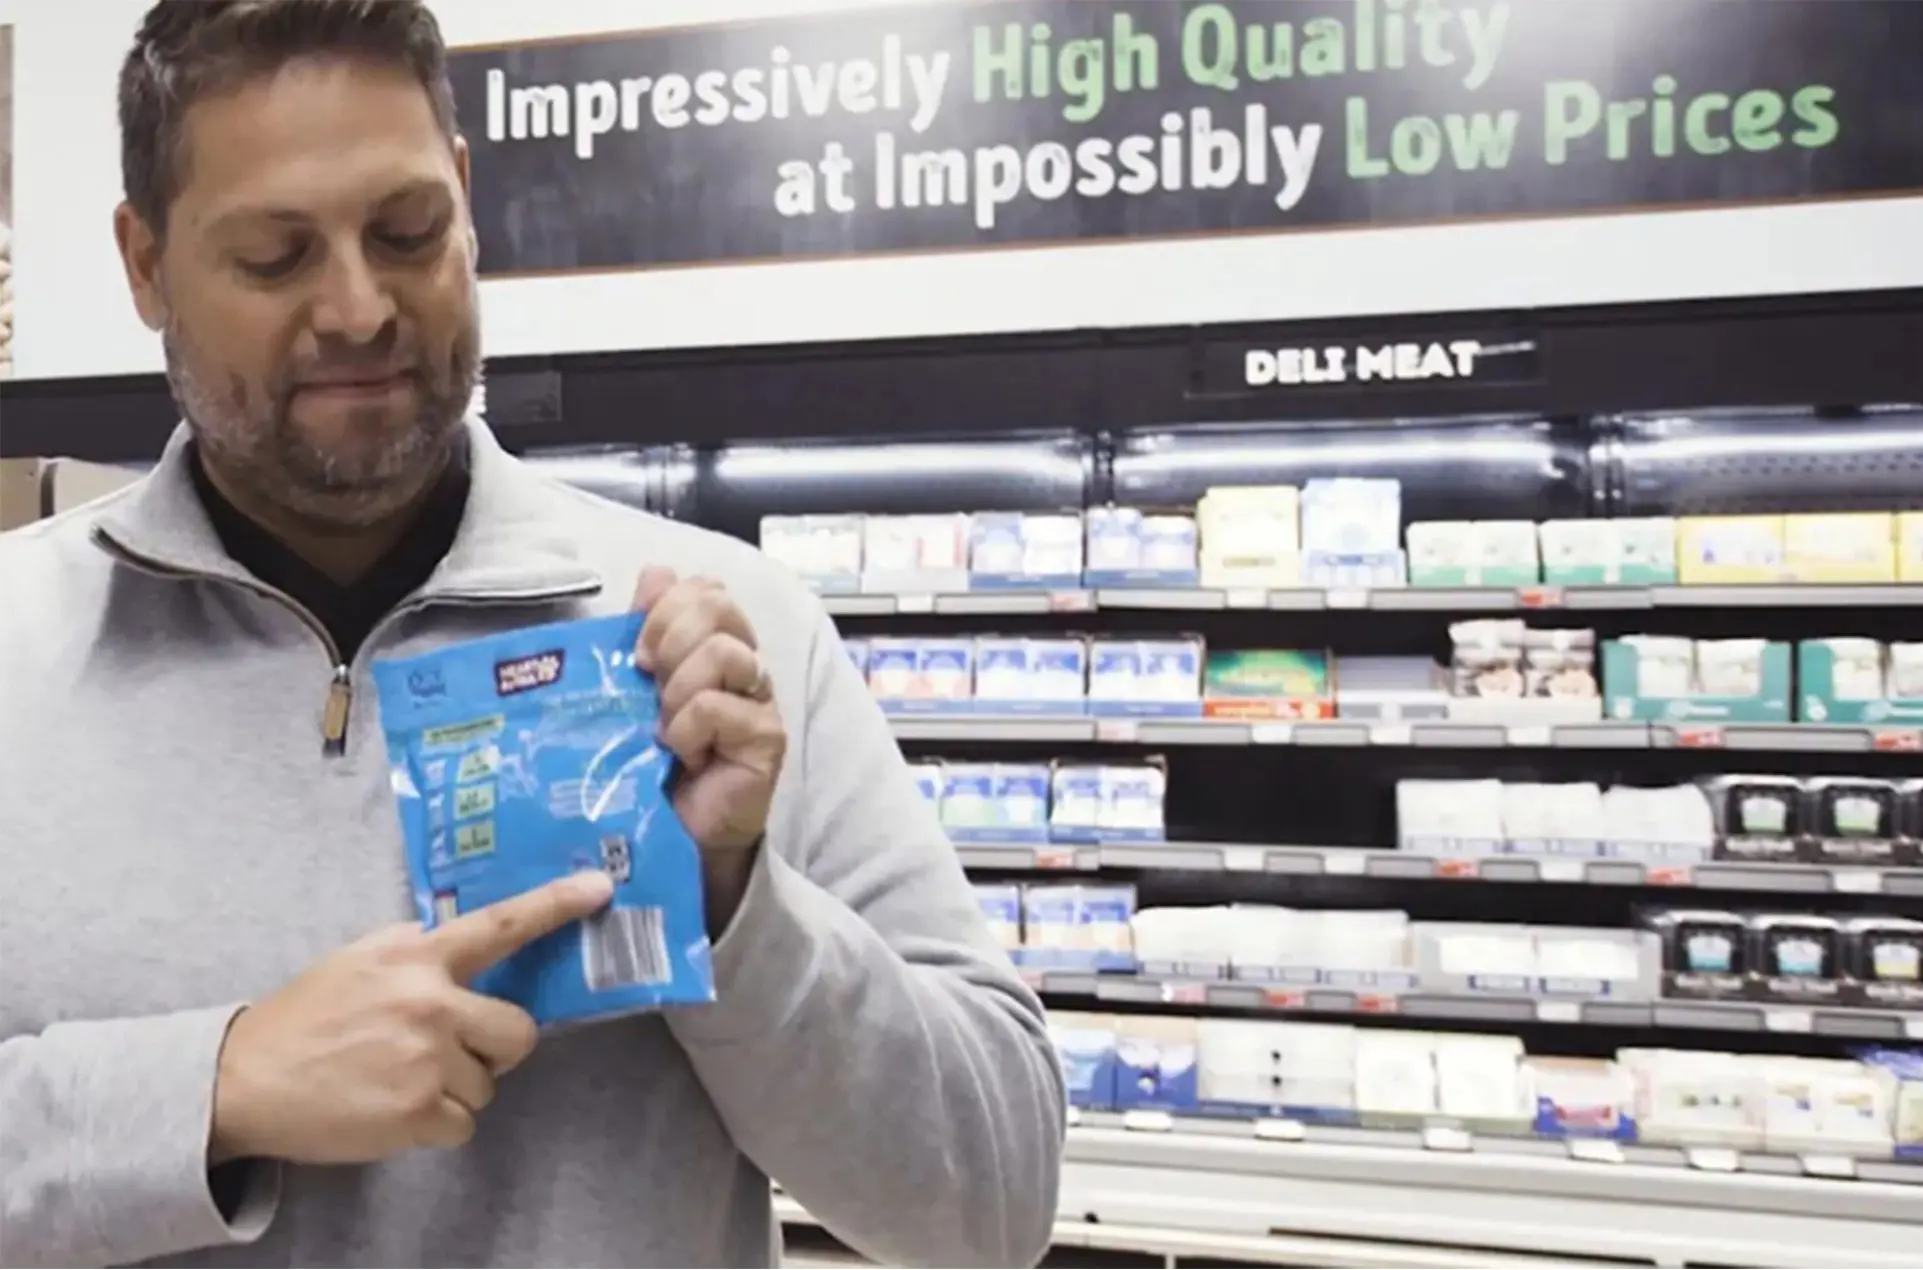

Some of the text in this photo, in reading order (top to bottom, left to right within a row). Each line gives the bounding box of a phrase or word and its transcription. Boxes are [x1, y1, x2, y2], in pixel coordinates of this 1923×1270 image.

[486, 0, 1510, 158] Impressively High Quality
[774, 76, 1839, 228] at Impossibly Low Prices
[1245, 341, 1481, 385] DELI MEAT
